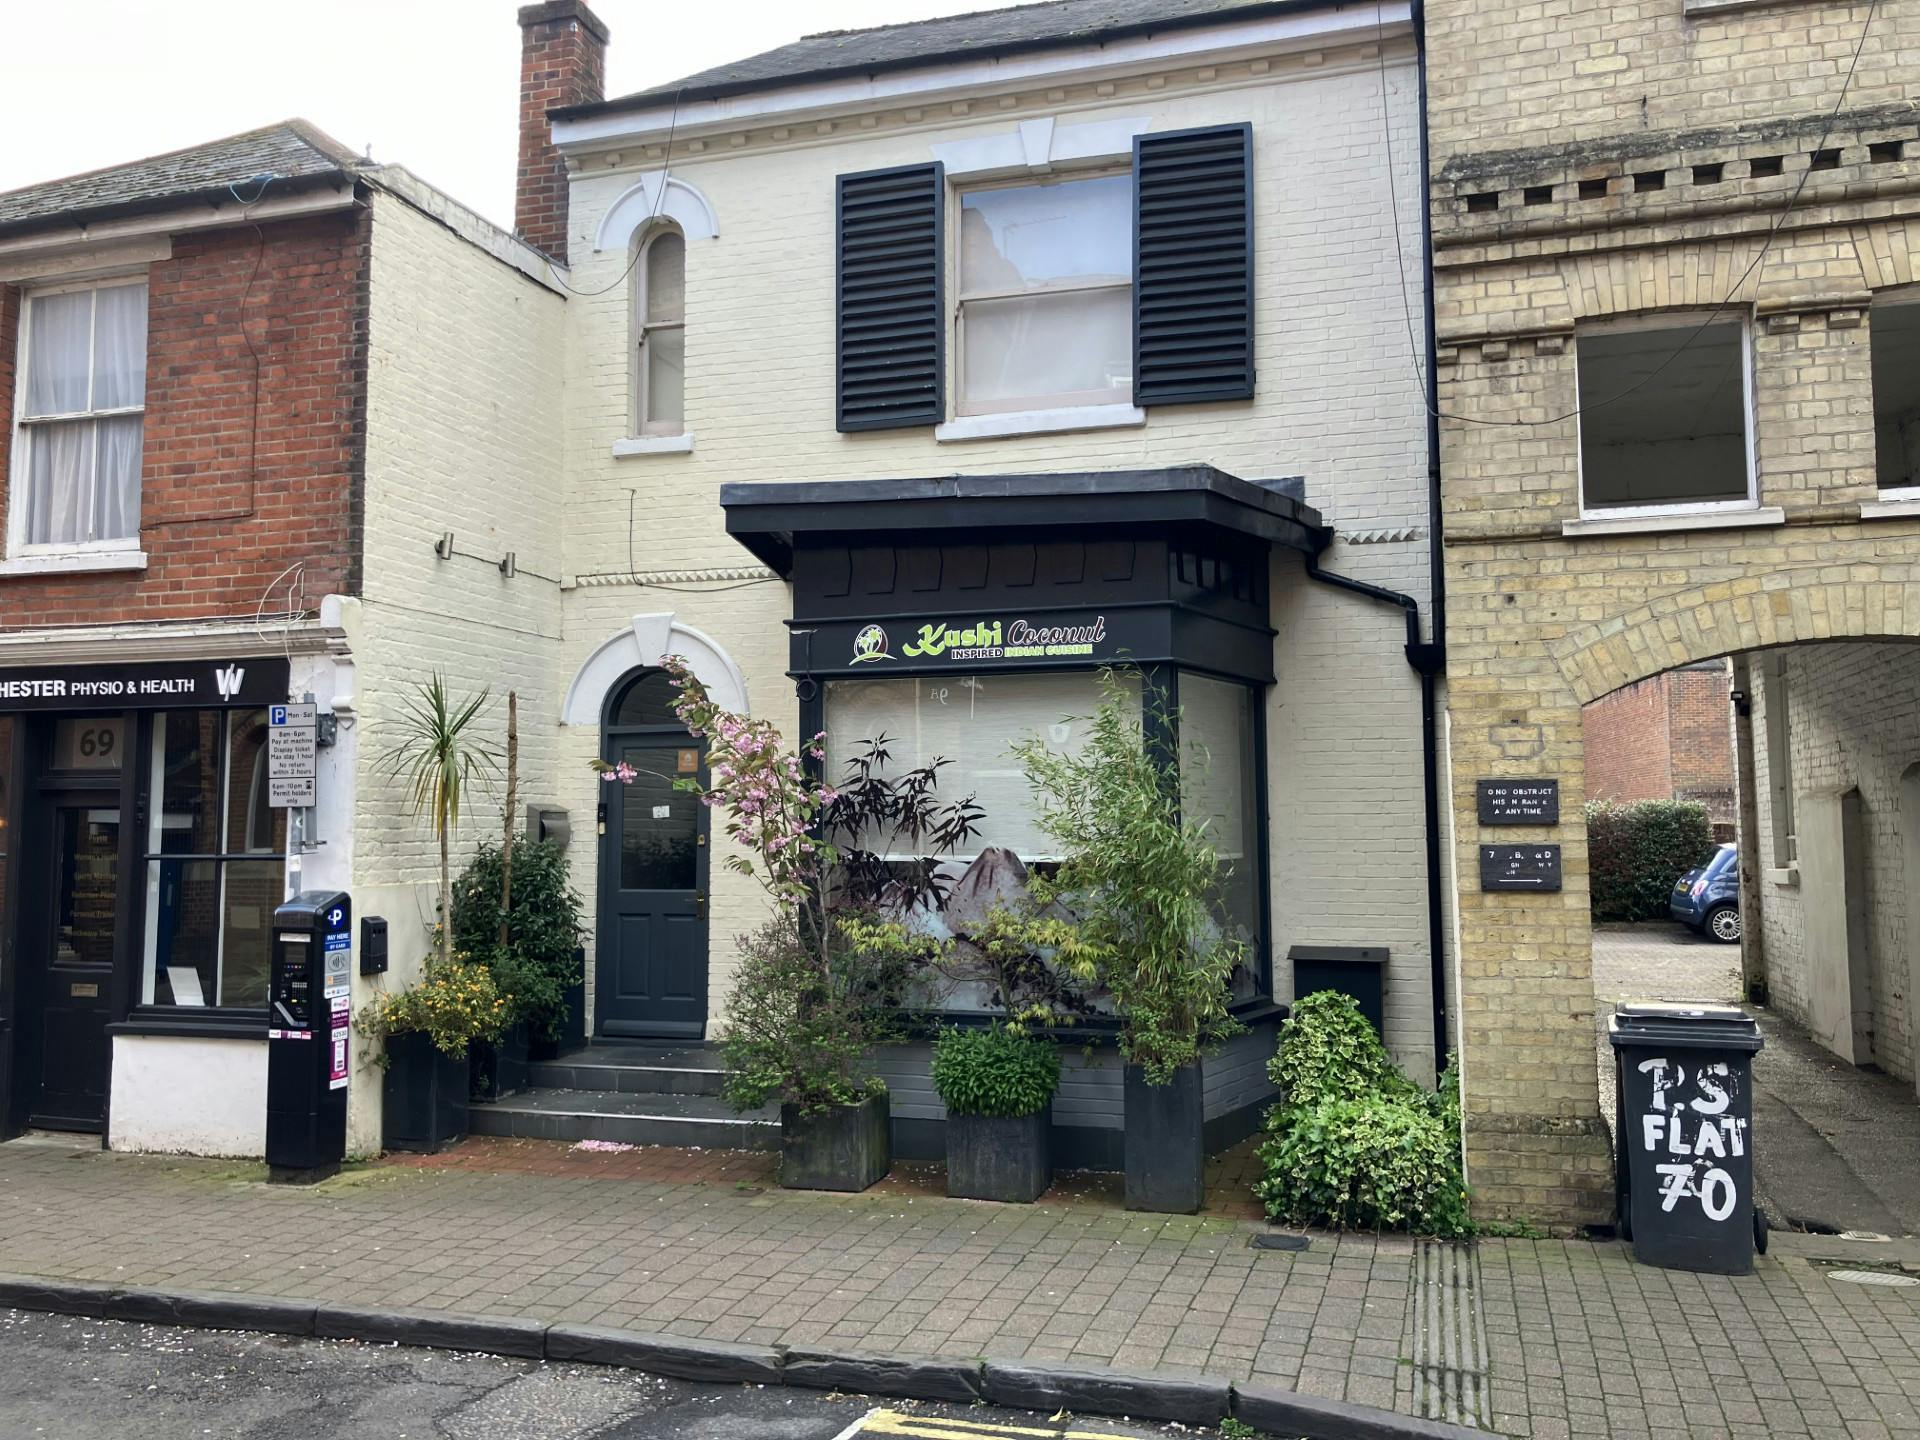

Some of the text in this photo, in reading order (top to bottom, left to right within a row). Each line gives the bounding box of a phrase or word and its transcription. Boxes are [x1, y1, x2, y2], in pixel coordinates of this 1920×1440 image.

[902, 616, 1107, 657] Kushi Coconut
[951, 643, 1094, 660] INSPIRED INDIAN CUISINE
[71, 681, 124, 696] PHYSIO
[127, 681, 137, 694] &
[140, 679, 195, 693] HEALTH
[79, 728, 116, 757] 69
[1643, 1114, 1747, 1158] FLAT
[1655, 1164, 1737, 1221] 70
